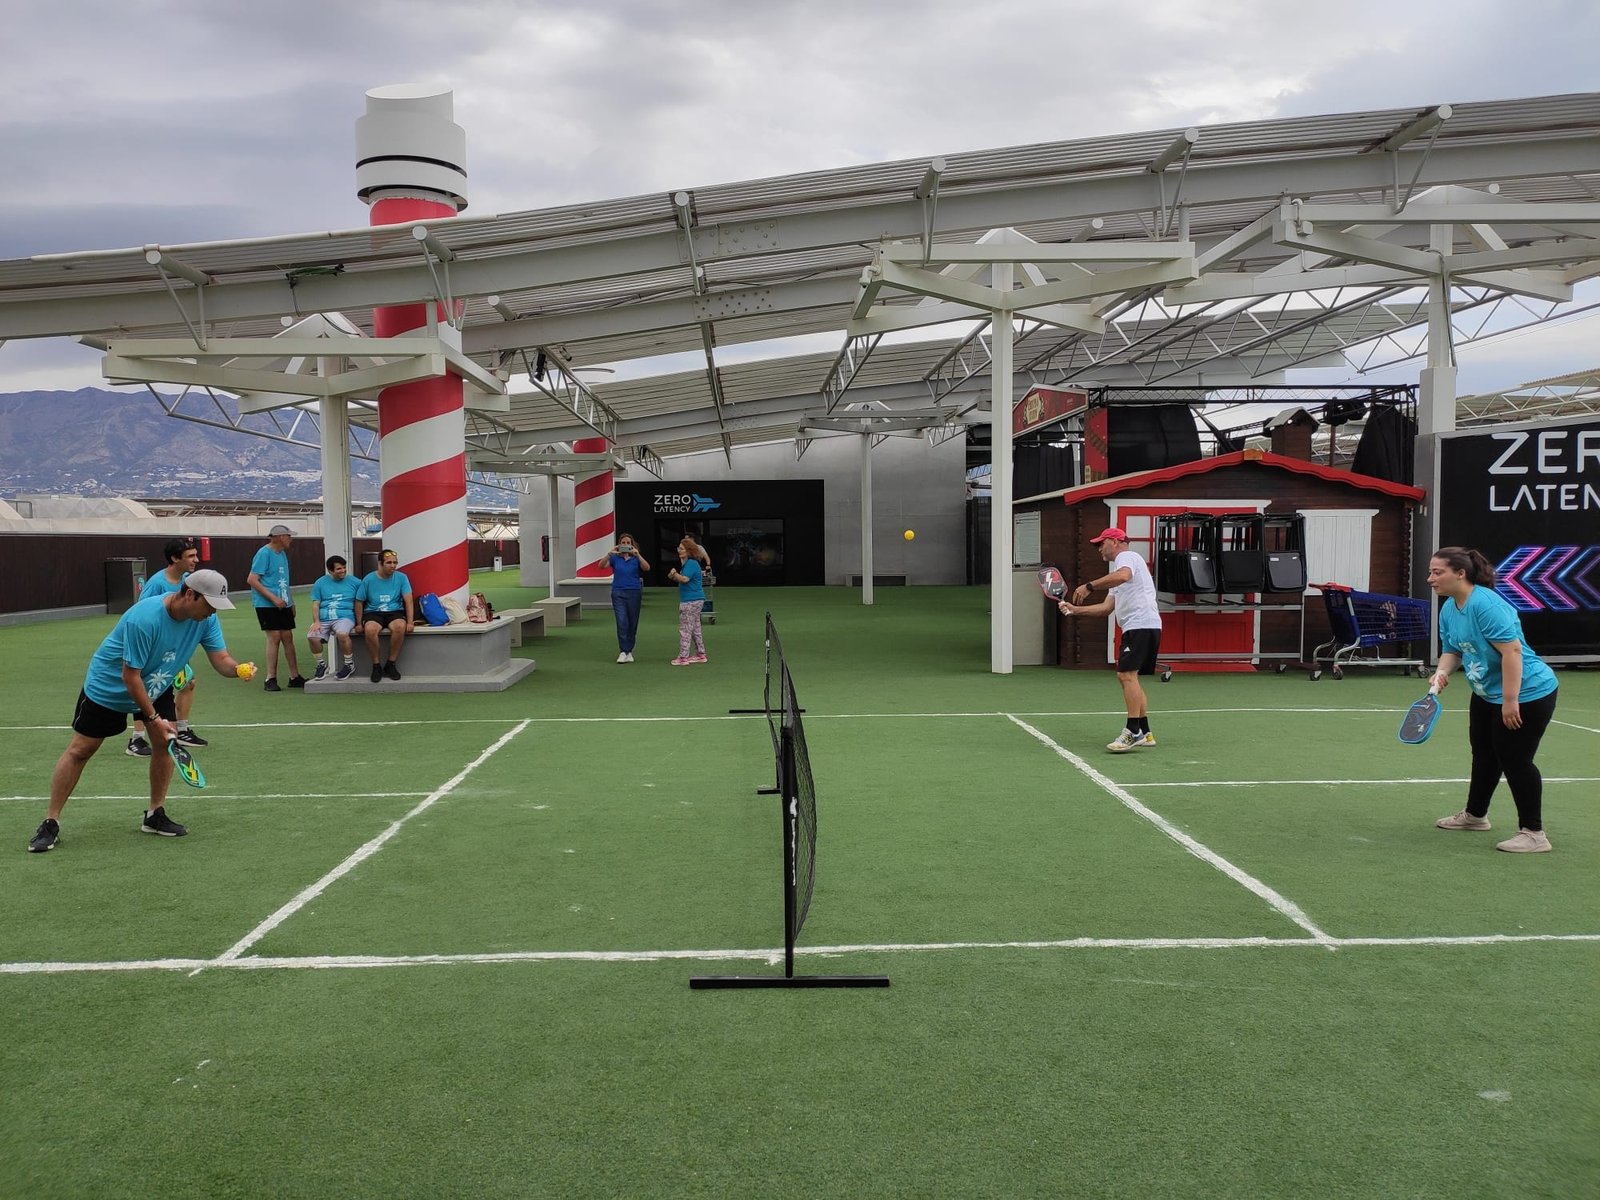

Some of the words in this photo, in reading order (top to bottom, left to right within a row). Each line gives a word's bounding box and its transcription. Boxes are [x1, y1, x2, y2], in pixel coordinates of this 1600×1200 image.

[1488, 431, 1600, 474] ZER
[654, 495, 691, 505] ZERO
[219, 585, 226, 596] A
